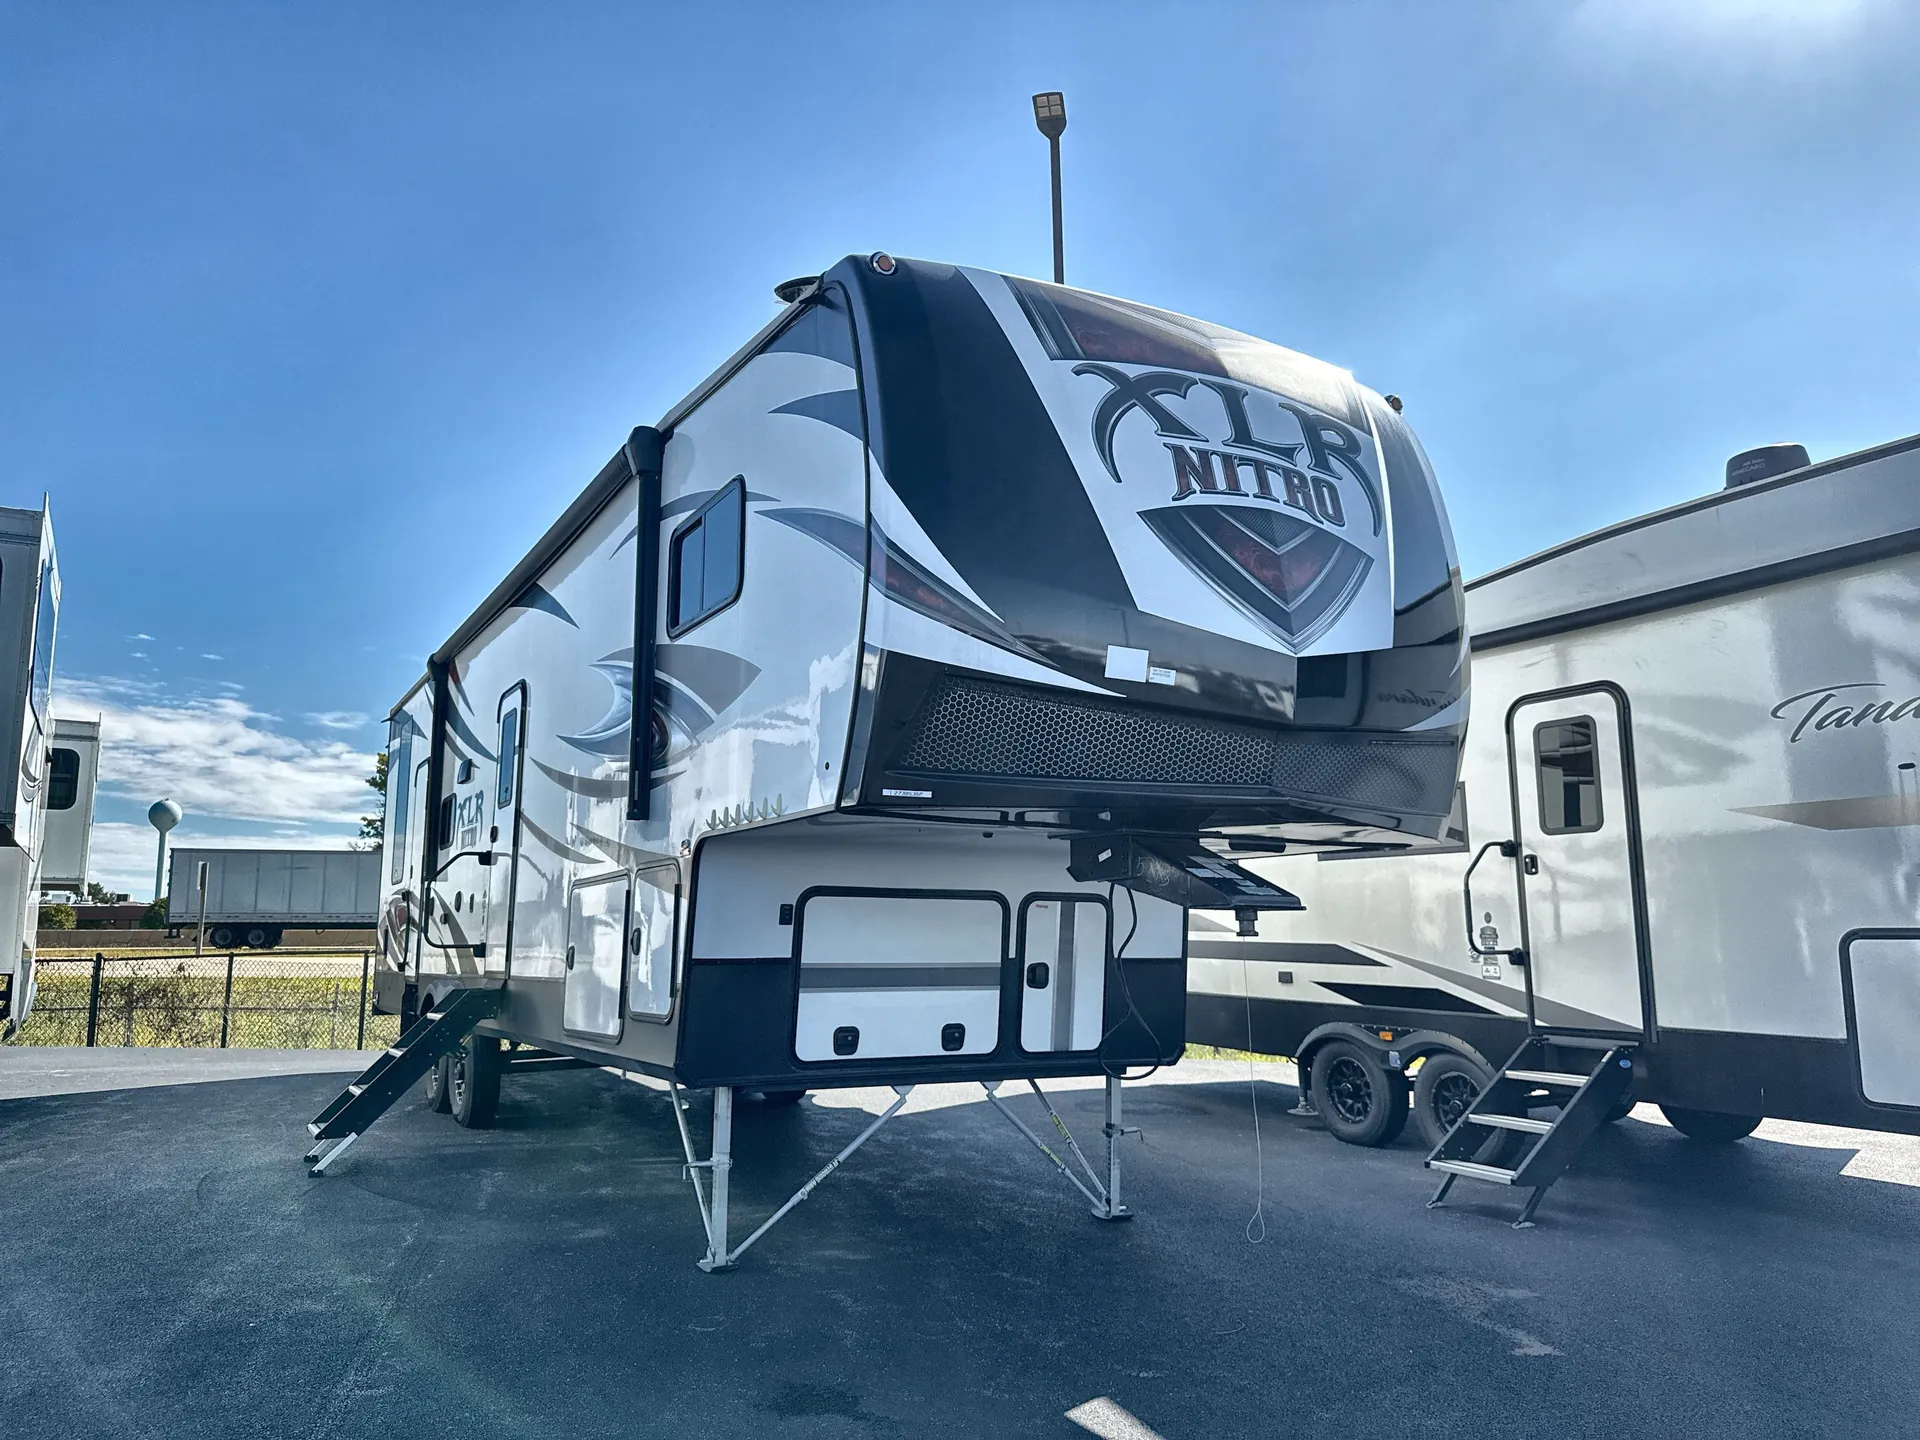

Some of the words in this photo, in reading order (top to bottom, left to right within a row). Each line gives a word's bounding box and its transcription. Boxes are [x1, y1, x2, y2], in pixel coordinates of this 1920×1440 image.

[1071, 362, 1384, 537] XLR
[1163, 442, 1346, 527] NITRO
[456, 789, 484, 850] XLR
